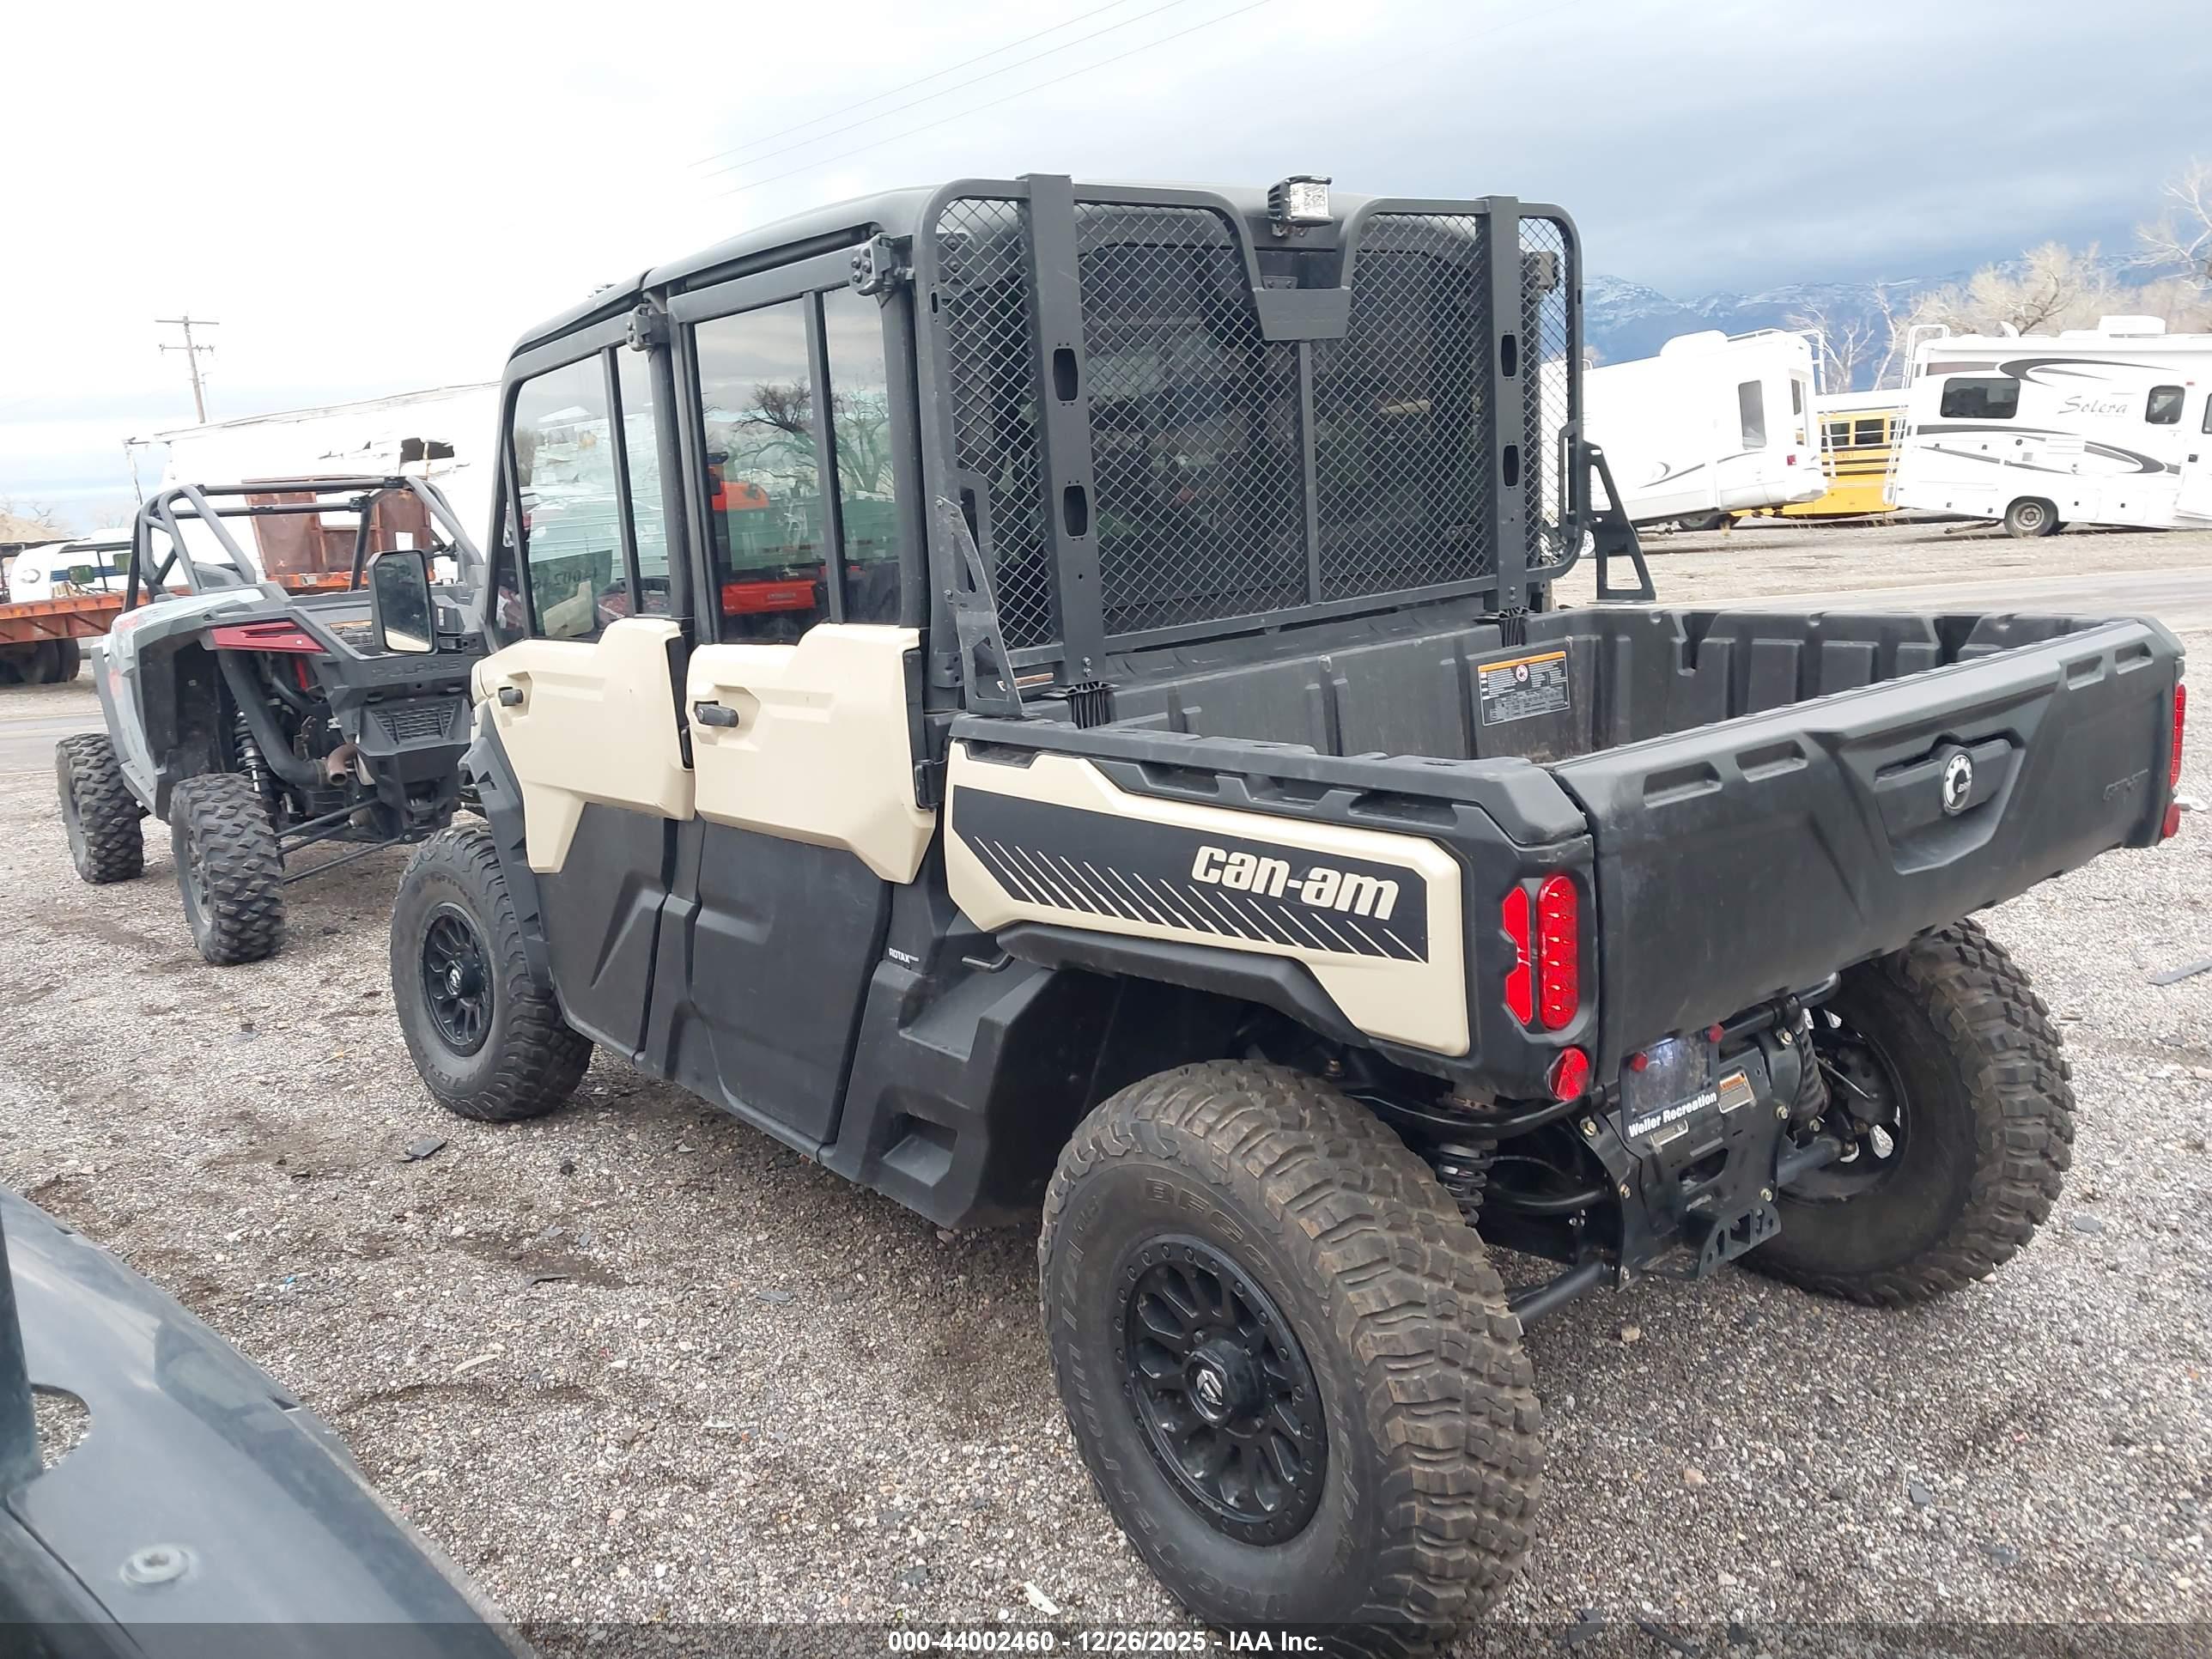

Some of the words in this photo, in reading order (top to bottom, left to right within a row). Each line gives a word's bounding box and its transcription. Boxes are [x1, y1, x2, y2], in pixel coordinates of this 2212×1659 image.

[2057, 395, 2128, 415] Solera
[372, 659, 461, 679] POLARIS
[888, 947, 910, 963] ROTAX
[1627, 1115, 1662, 1138] Weller
[1662, 1091, 1717, 1123] Recreation
